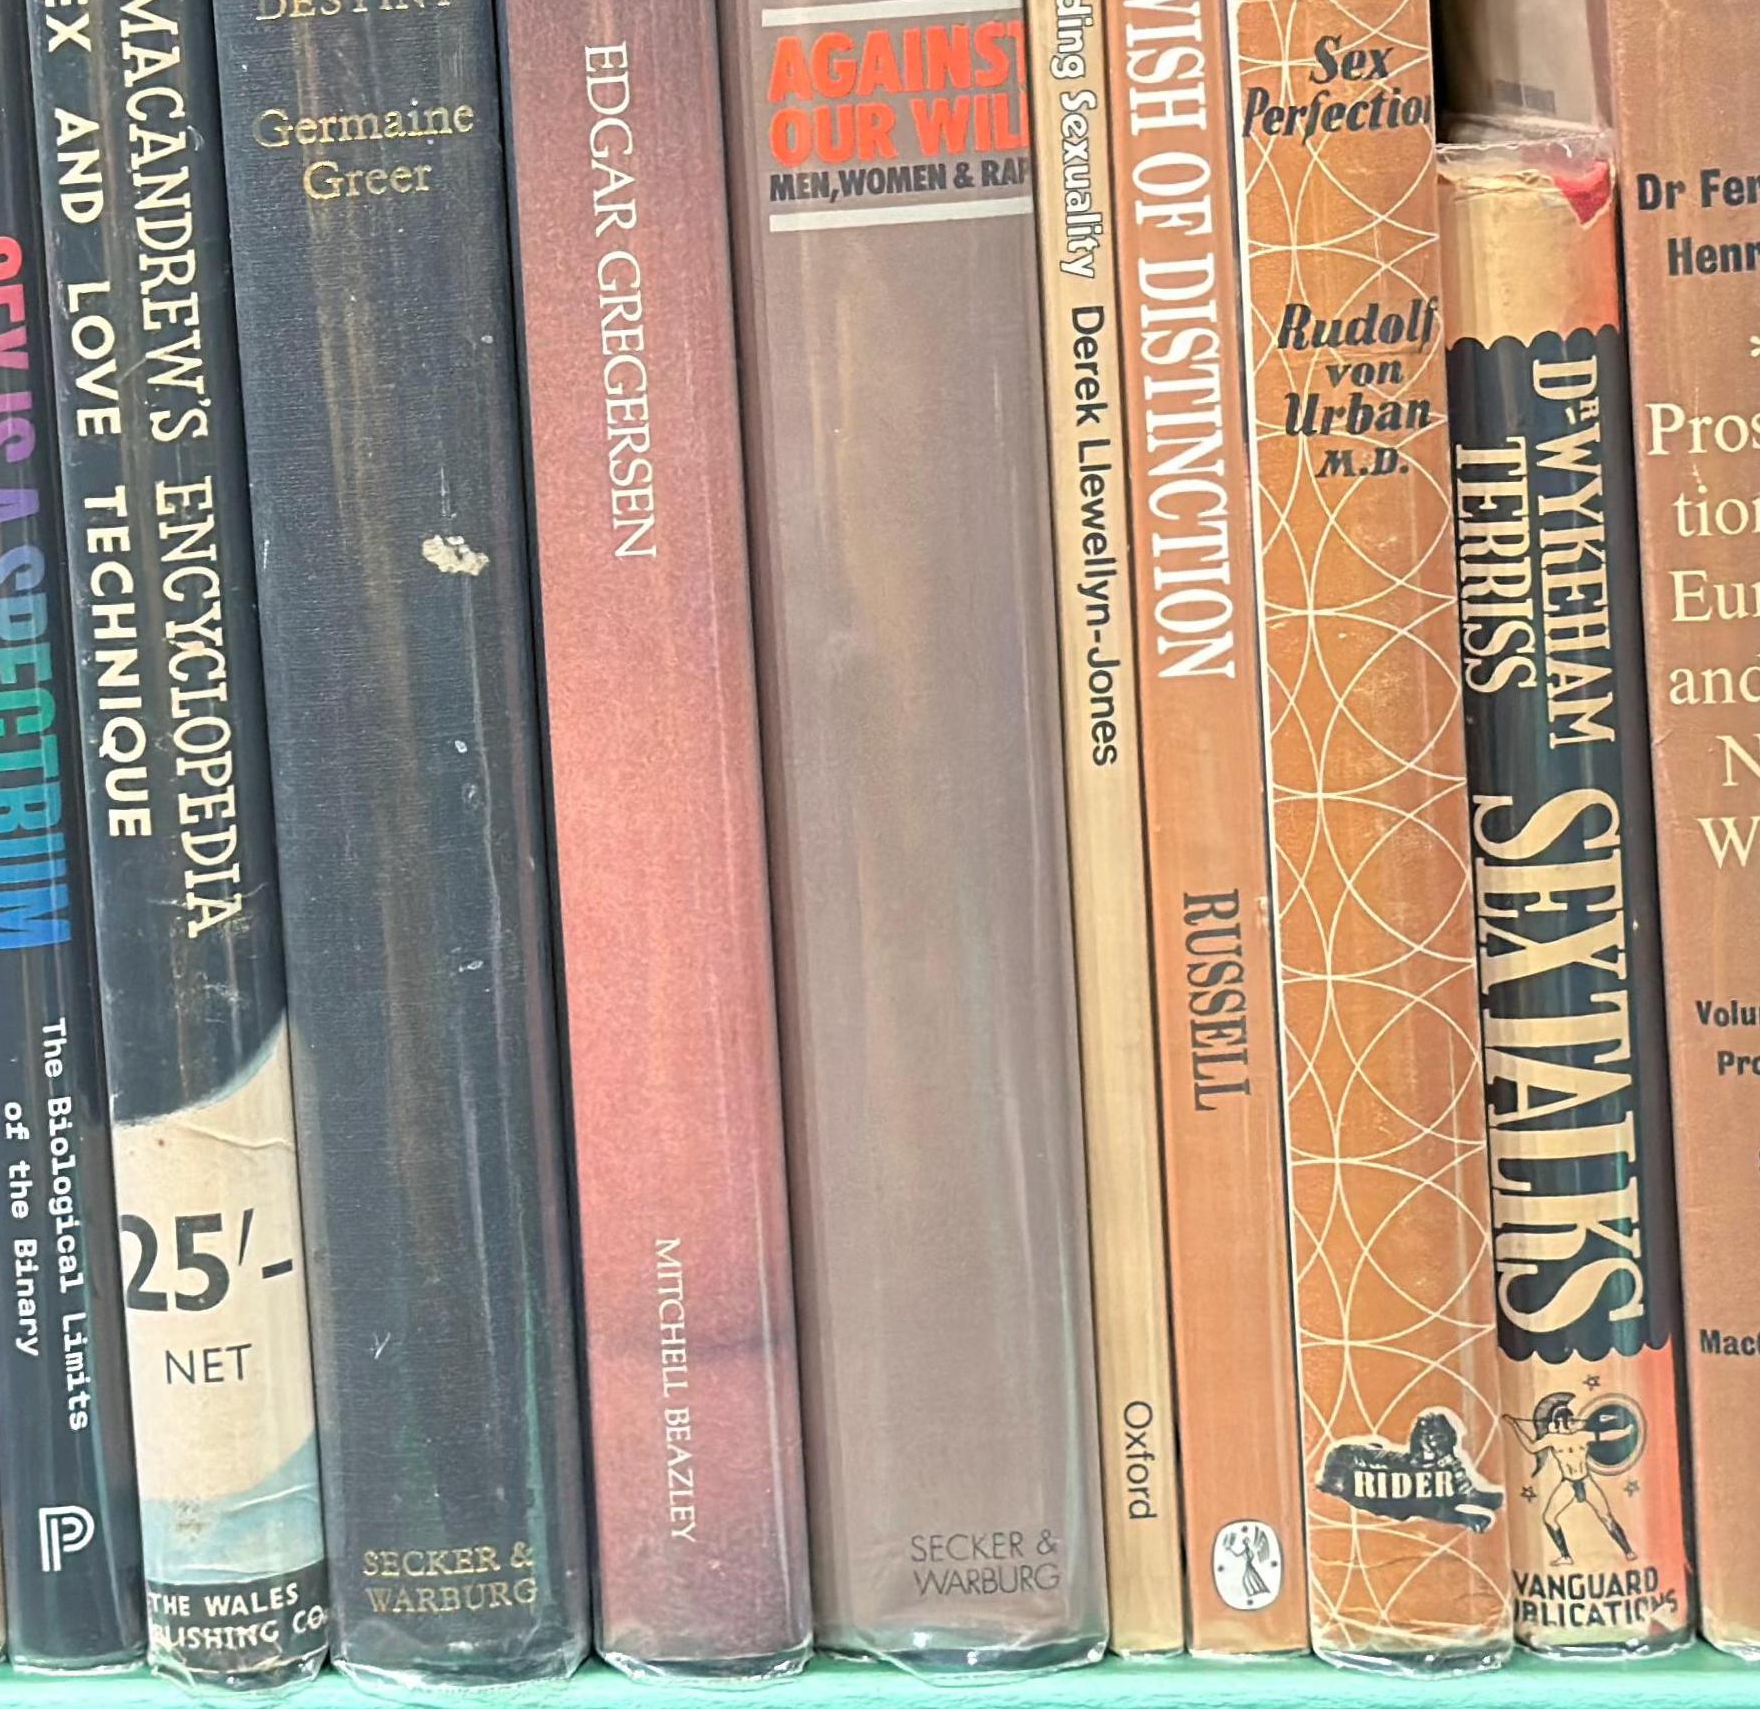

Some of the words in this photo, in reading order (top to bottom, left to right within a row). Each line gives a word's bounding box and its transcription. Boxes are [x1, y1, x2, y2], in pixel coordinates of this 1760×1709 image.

[1309, 36, 1395, 86] Sex
[253, 102, 475, 150] Germaine
[584, 41, 638, 238] EDGAR
[770, 101, 898, 167] OUR
[53, 106, 104, 225] AND
[302, 158, 432, 201] Greer
[953, 161, 974, 188] &
[1058, 90, 1104, 278] Sexuality
[1132, 151, 1215, 237] OF
[1636, 172, 1685, 211] Dr
[1276, 296, 1439, 352] Rudolf
[61, 280, 122, 437] LOVE
[1072, 304, 1108, 426] Derek
[1326, 358, 1403, 388] von
[596, 250, 657, 560] GREGERSEN
[1283, 392, 1431, 438] Urban
[1138, 252, 1236, 679] DISTINCTION
[1316, 445, 1410, 480] M.D.
[1076, 438, 1120, 767] Llewellyn-Jones
[83, 486, 151, 838] TECHNIQUE
[1182, 887, 1250, 1113] RUSSELL
[42, 1018, 66, 1079] The
[5, 1100, 30, 1141] of
[8, 1161, 31, 1220] the
[47, 1097, 85, 1294] Biological
[13, 1238, 40, 1359] Binary
[655, 1238, 689, 1399] MITCHELL
[61, 1311, 92, 1432] Limits
[165, 1344, 252, 1385] NET
[664, 1406, 696, 1543] BEAZLEY
[1122, 1399, 1158, 1520] Oxford
[1353, 1468, 1454, 1502] RIDER
[362, 1546, 500, 1577] SECKER
[509, 1541, 535, 1568] &
[910, 1530, 1023, 1562] SECKER
[1036, 1528, 1057, 1557] &
[149, 1592, 190, 1617] THE
[203, 1582, 299, 1617] WALES
[365, 1577, 537, 1613] WARBURG
[913, 1562, 1060, 1596] WARBURG
[1512, 1566, 1658, 1600] VANGUARD
